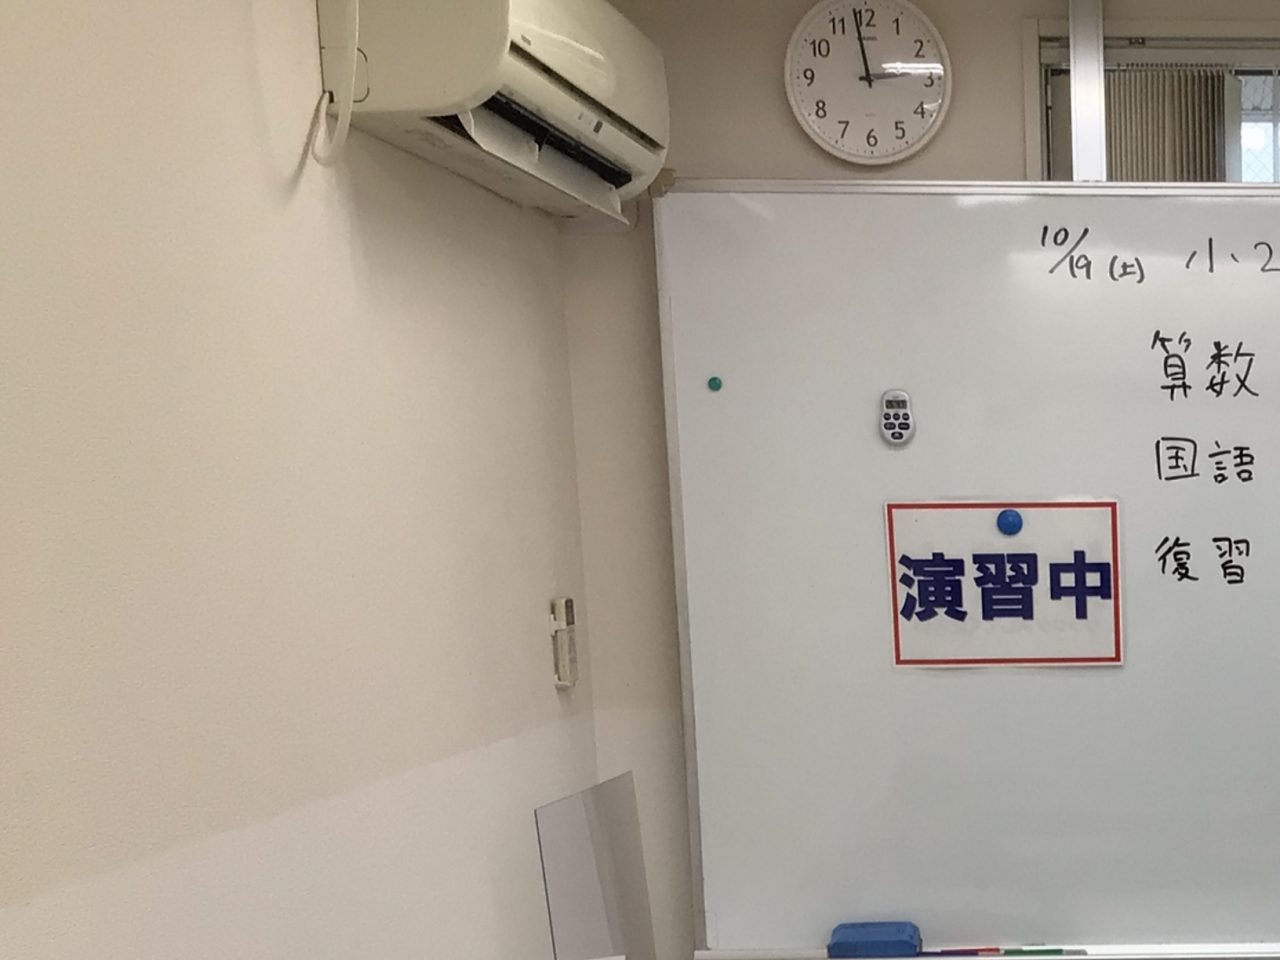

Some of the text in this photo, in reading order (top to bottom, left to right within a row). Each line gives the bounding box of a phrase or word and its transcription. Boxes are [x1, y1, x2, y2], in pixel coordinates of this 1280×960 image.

[829, 17, 846, 35] 11
[855, 8, 876, 28] 12
[892, 18, 901, 36] 1
[809, 38, 831, 58] 10
[914, 39, 926, 59] 2
[803, 68, 815, 87] 9
[923, 72, 935, 88] 3
[815, 100, 827, 119] 8
[913, 101, 926, 119] 4
[838, 120, 850, 139] 7
[866, 128, 878, 147] 6
[894, 121, 906, 140] 5
[1154, 535, 1251, 586] 復習
[898, 550, 1112, 622] 演習中
